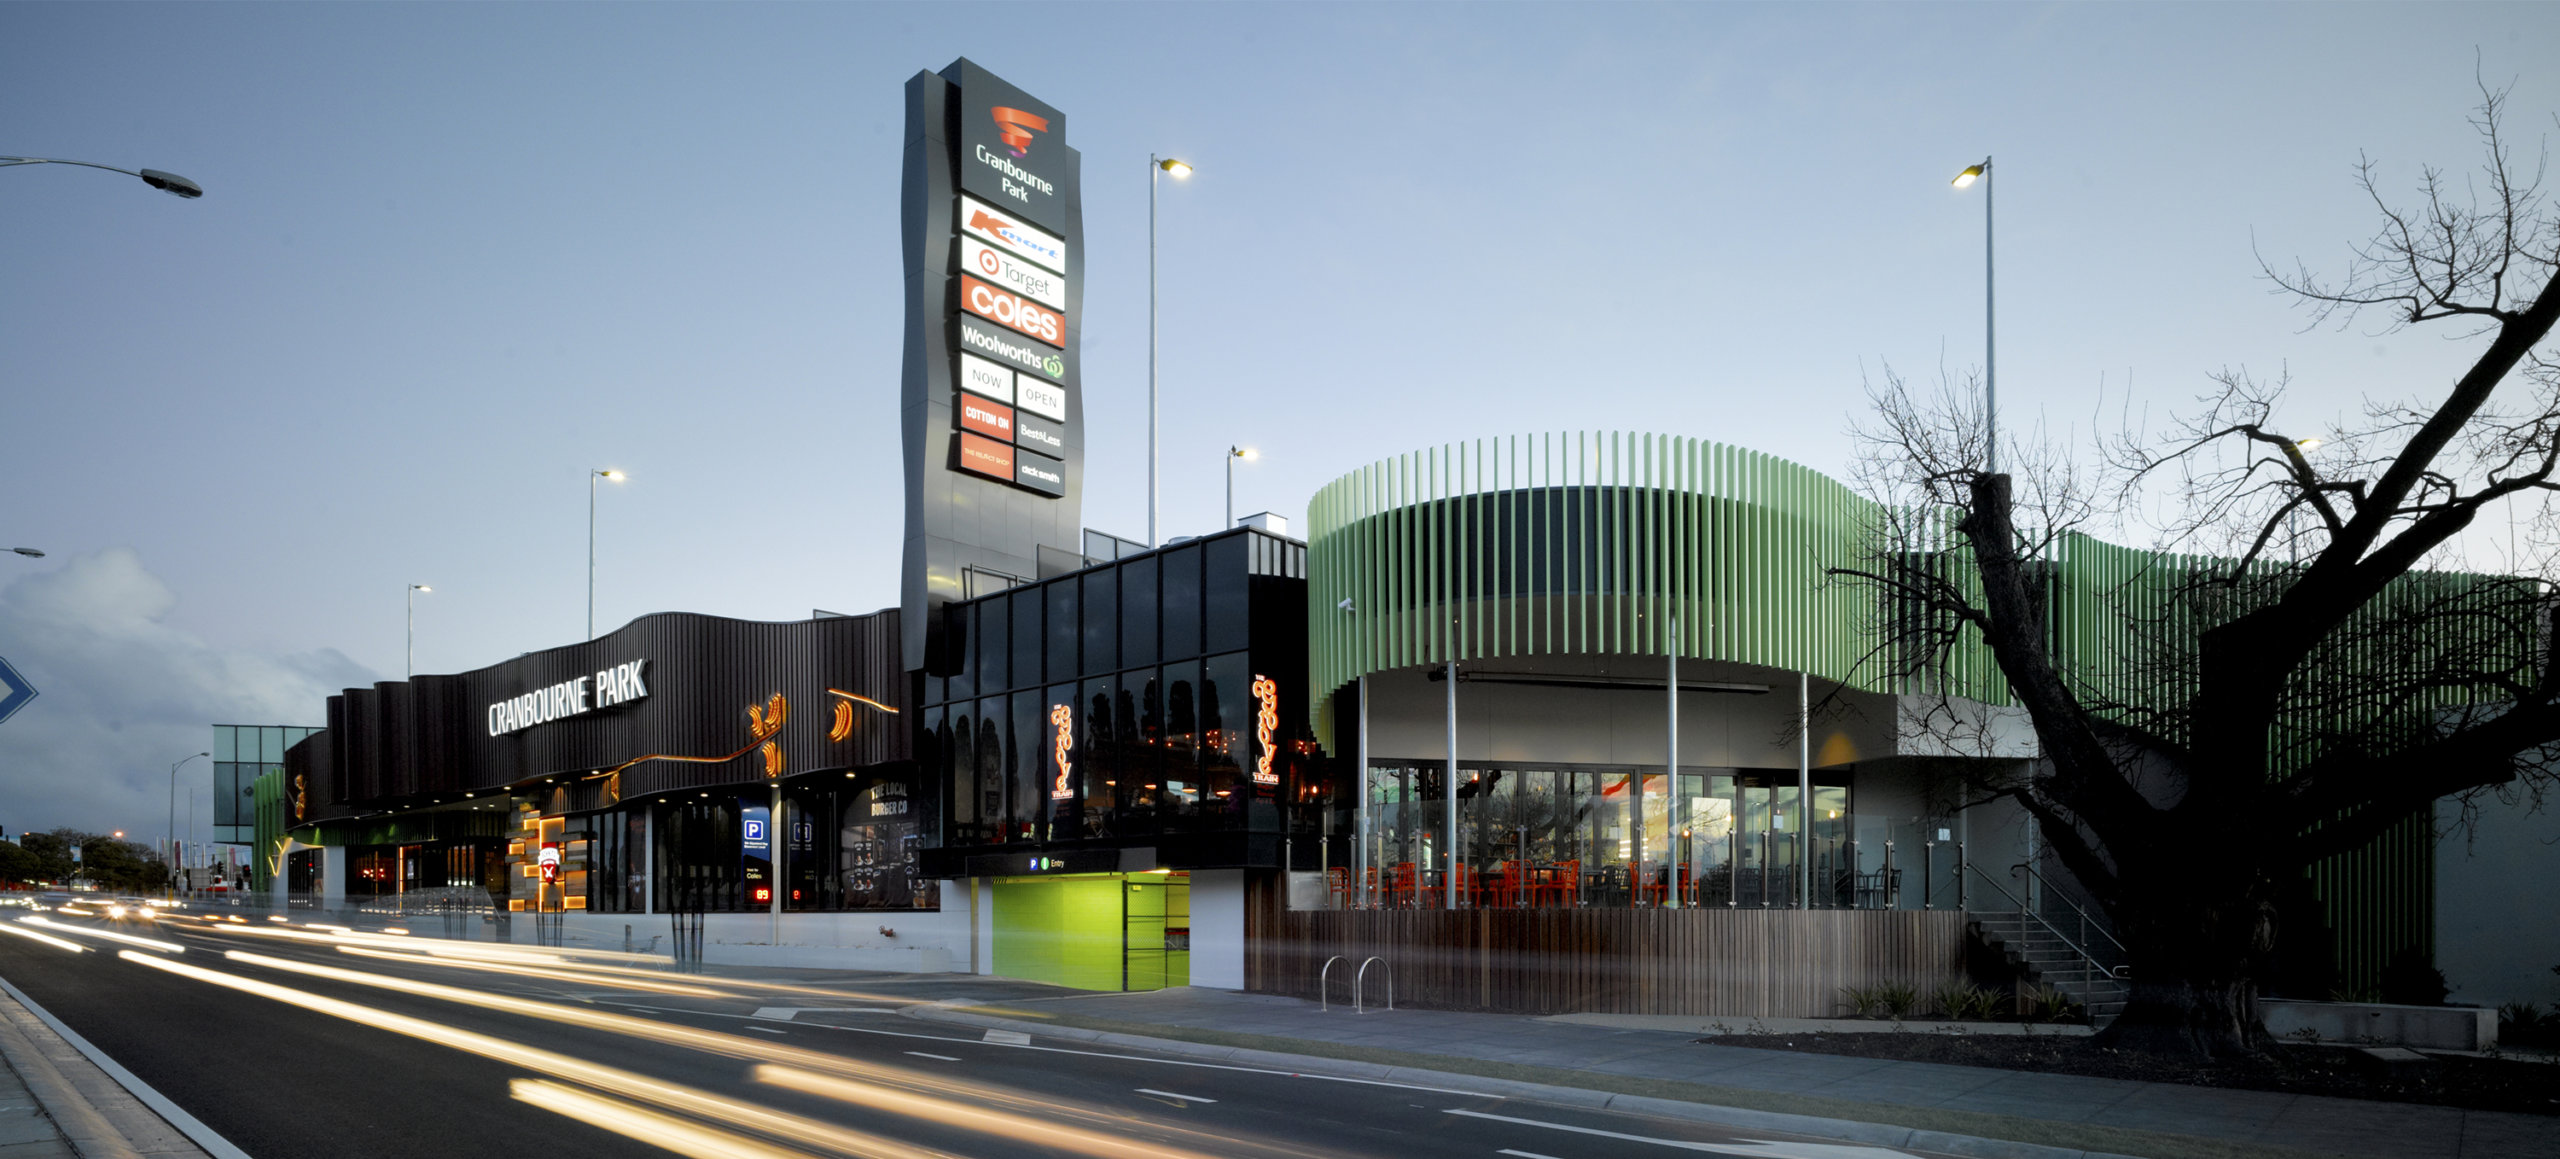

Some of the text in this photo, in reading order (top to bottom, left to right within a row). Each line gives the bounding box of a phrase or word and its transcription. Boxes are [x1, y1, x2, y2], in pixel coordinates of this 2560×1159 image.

[976, 144, 1053, 196] Cranbourne
[1002, 178, 1028, 203] Park
[1002, 261, 1050, 295] Target
[971, 285, 1057, 341] coles
[962, 324, 1042, 369] Woolworths
[972, 369, 1002, 389] NOW
[1025, 388, 1057, 409] OPEN
[965, 406, 1009, 431] COTTON ON
[488, 658, 649, 737] CRANBOURNE PARK
[1253, 772, 1279, 784] TRAIN
[870, 782, 907, 801] THE LOCAL
[871, 799, 908, 816] BURGER CO
[1051, 859, 1064, 869] Entry
